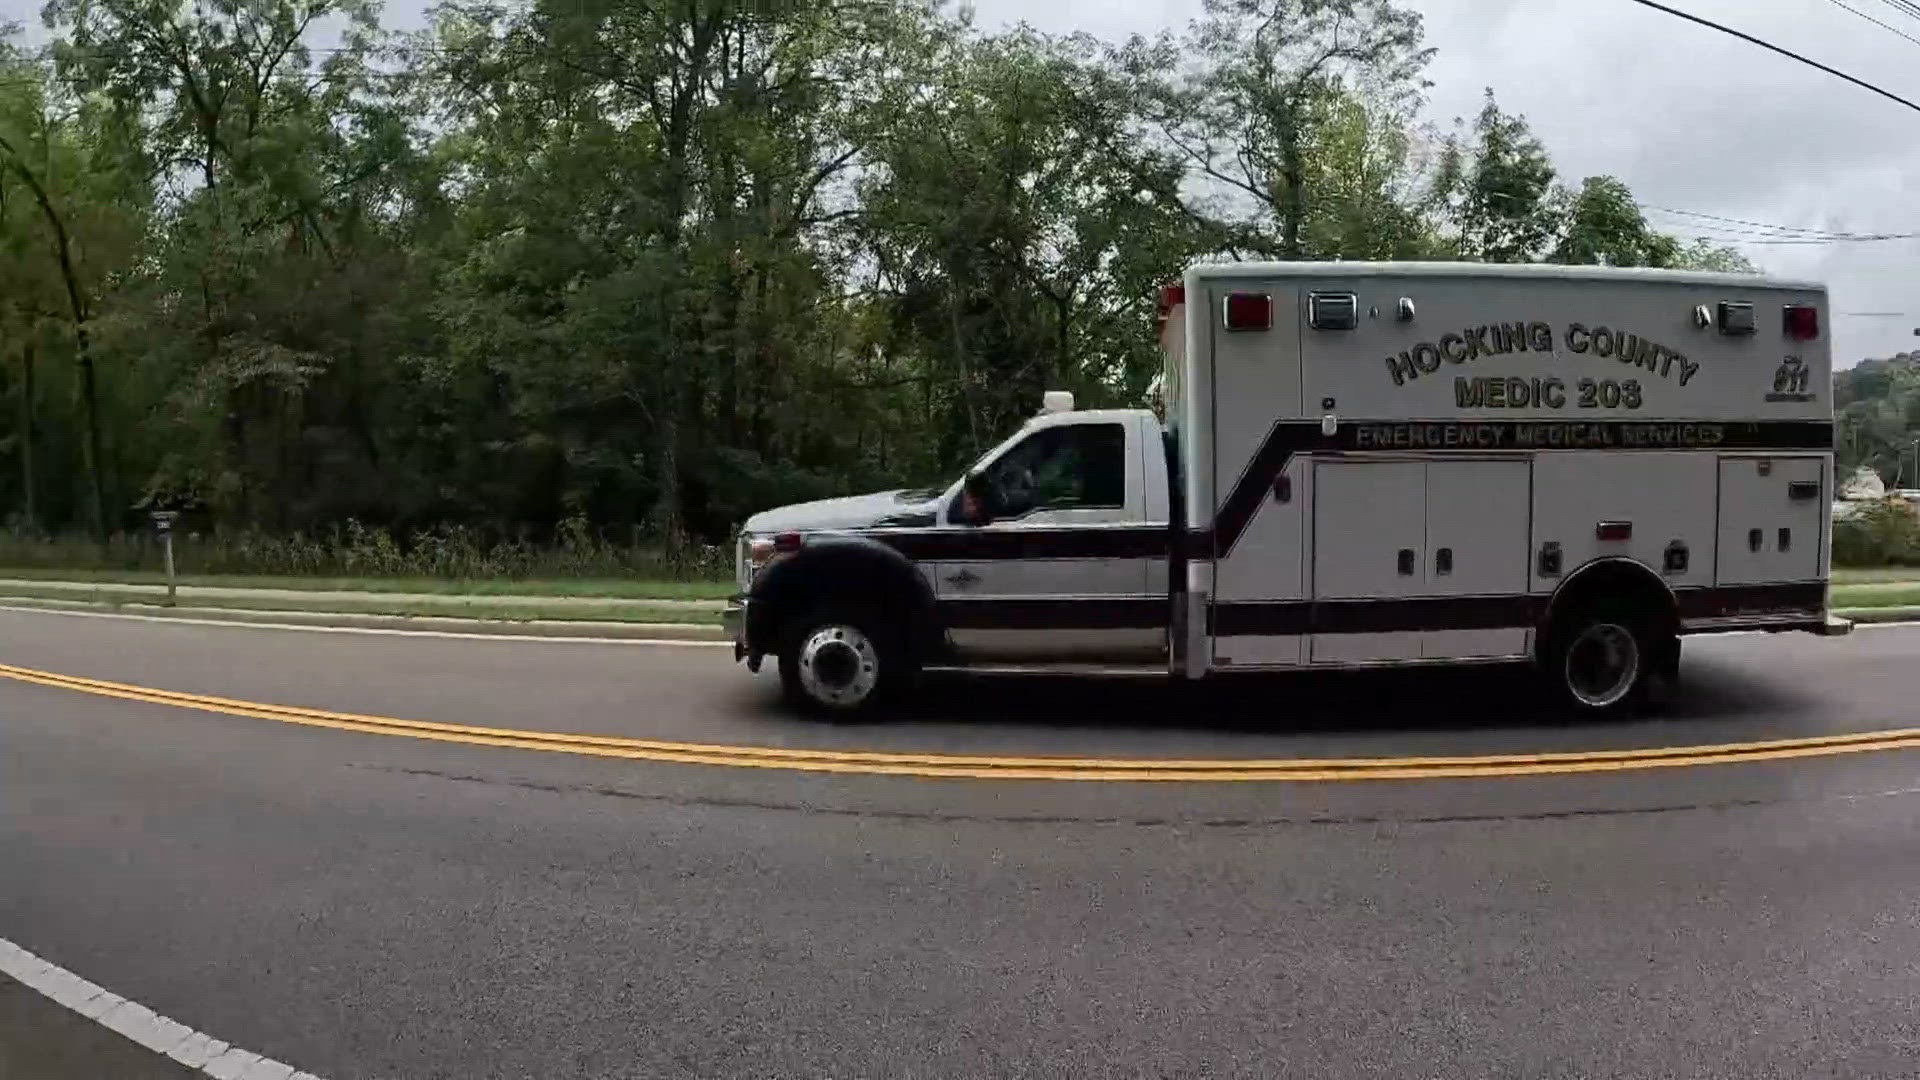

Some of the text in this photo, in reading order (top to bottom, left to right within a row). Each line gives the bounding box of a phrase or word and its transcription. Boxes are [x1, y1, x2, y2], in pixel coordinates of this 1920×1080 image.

[1385, 321, 1699, 387] HOCKING COUNTY
[1454, 377, 1566, 408] MEDIC
[1356, 425, 1504, 446] EMERGENCY
[1515, 424, 1614, 445] MEDICAL
